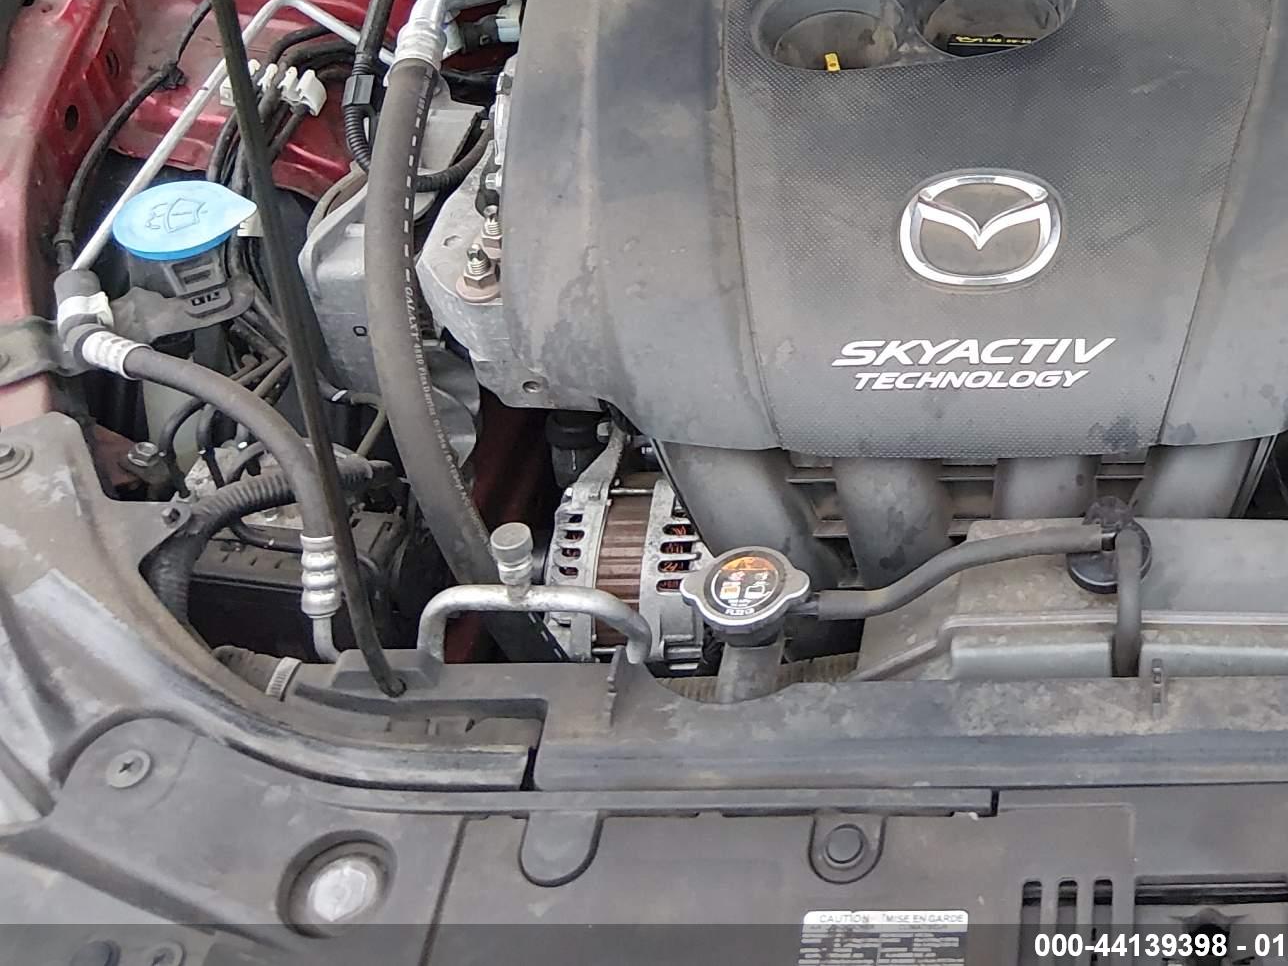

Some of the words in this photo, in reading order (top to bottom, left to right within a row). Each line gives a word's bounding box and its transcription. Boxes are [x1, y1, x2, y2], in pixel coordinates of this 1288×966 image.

[831, 337, 1118, 367] SKYACTIV
[854, 370, 1090, 391] TECHNOLOGY
[819, 914, 869, 924] CAUTION
[913, 914, 925, 924] EN
[927, 914, 964, 924] GARDE
